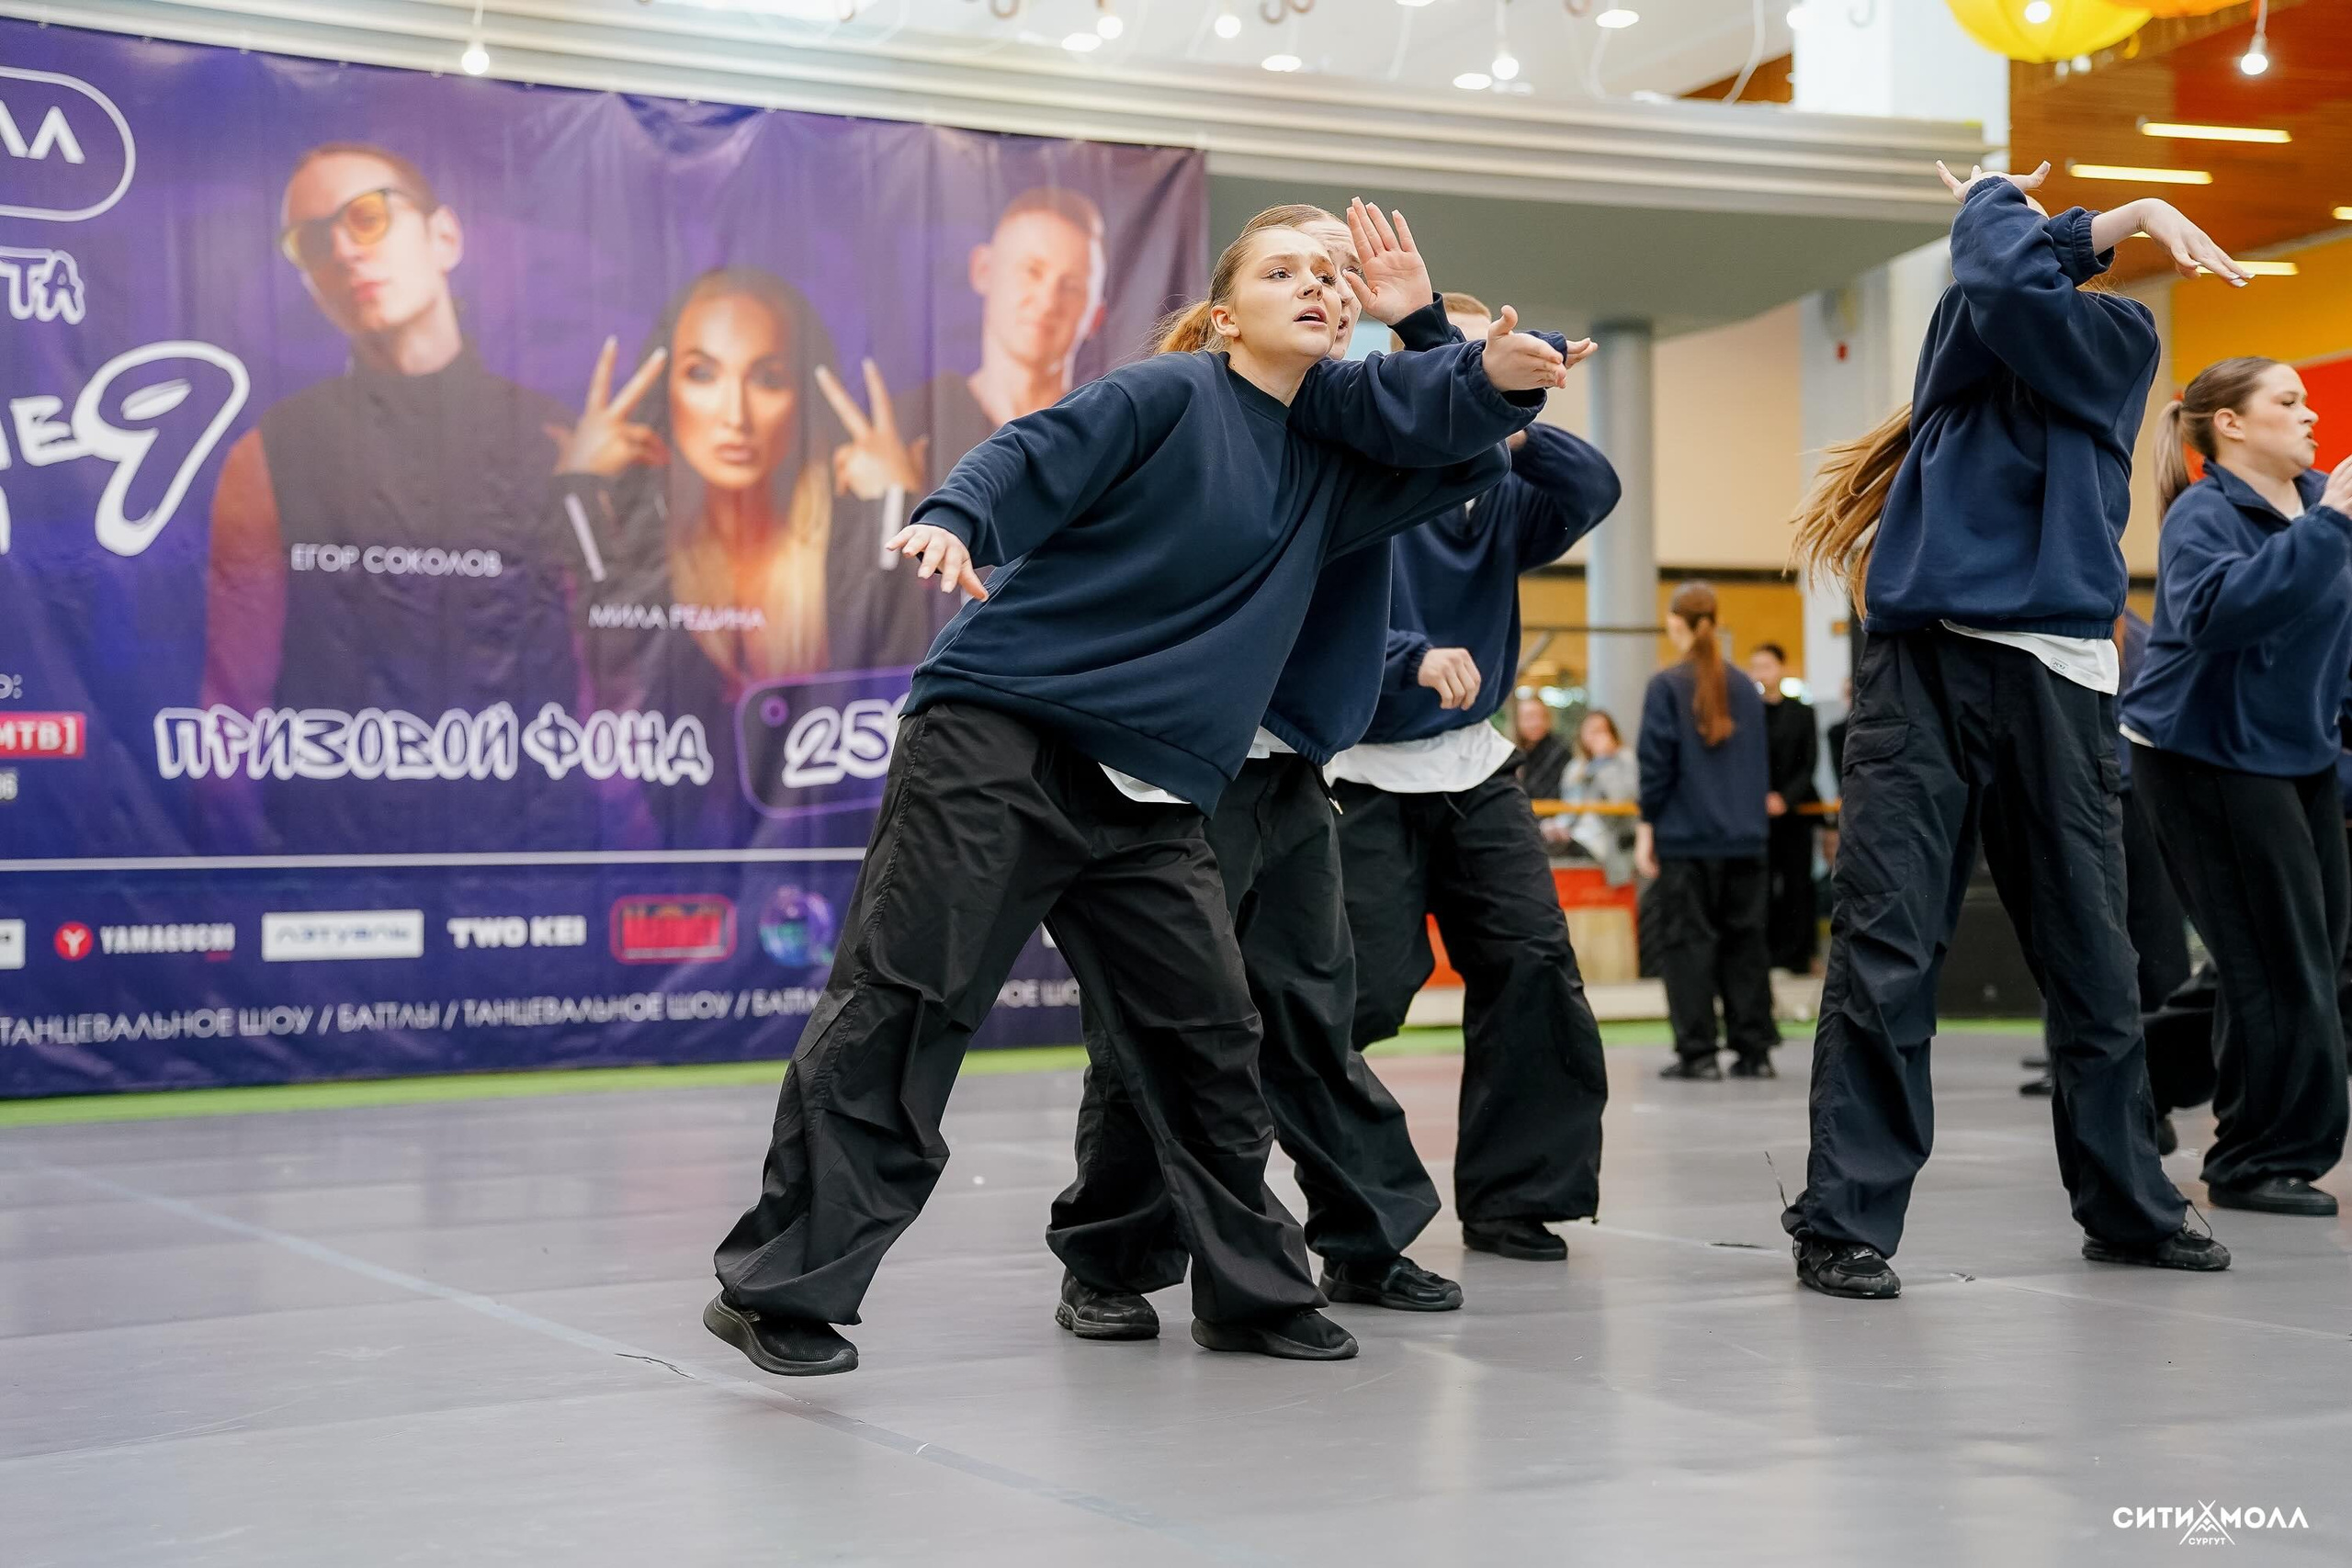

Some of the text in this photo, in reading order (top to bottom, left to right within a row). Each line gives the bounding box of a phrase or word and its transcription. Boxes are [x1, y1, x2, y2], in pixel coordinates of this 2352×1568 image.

[291, 543, 503, 577] ЕГОР СОКОЛОВ
[588, 604, 668, 630] МИЛА
[153, 701, 519, 781] ПРИЗОВОЙ
[782, 692, 895, 788] 25
[100, 922, 235, 954] YAMAGUCHI
[447, 916, 528, 949] TWO
[530, 915, 587, 947] KEI
[0, 1008, 233, 1046] ТАНЦЕВАЛЬНОЕ
[239, 1005, 313, 1035] ШОУ
[337, 999, 440, 1032] БАТТЛЫ
[464, 991, 665, 1028] ТАНЦЕВАЛЬНОЕ
[666, 989, 734, 1021] ШОУ
